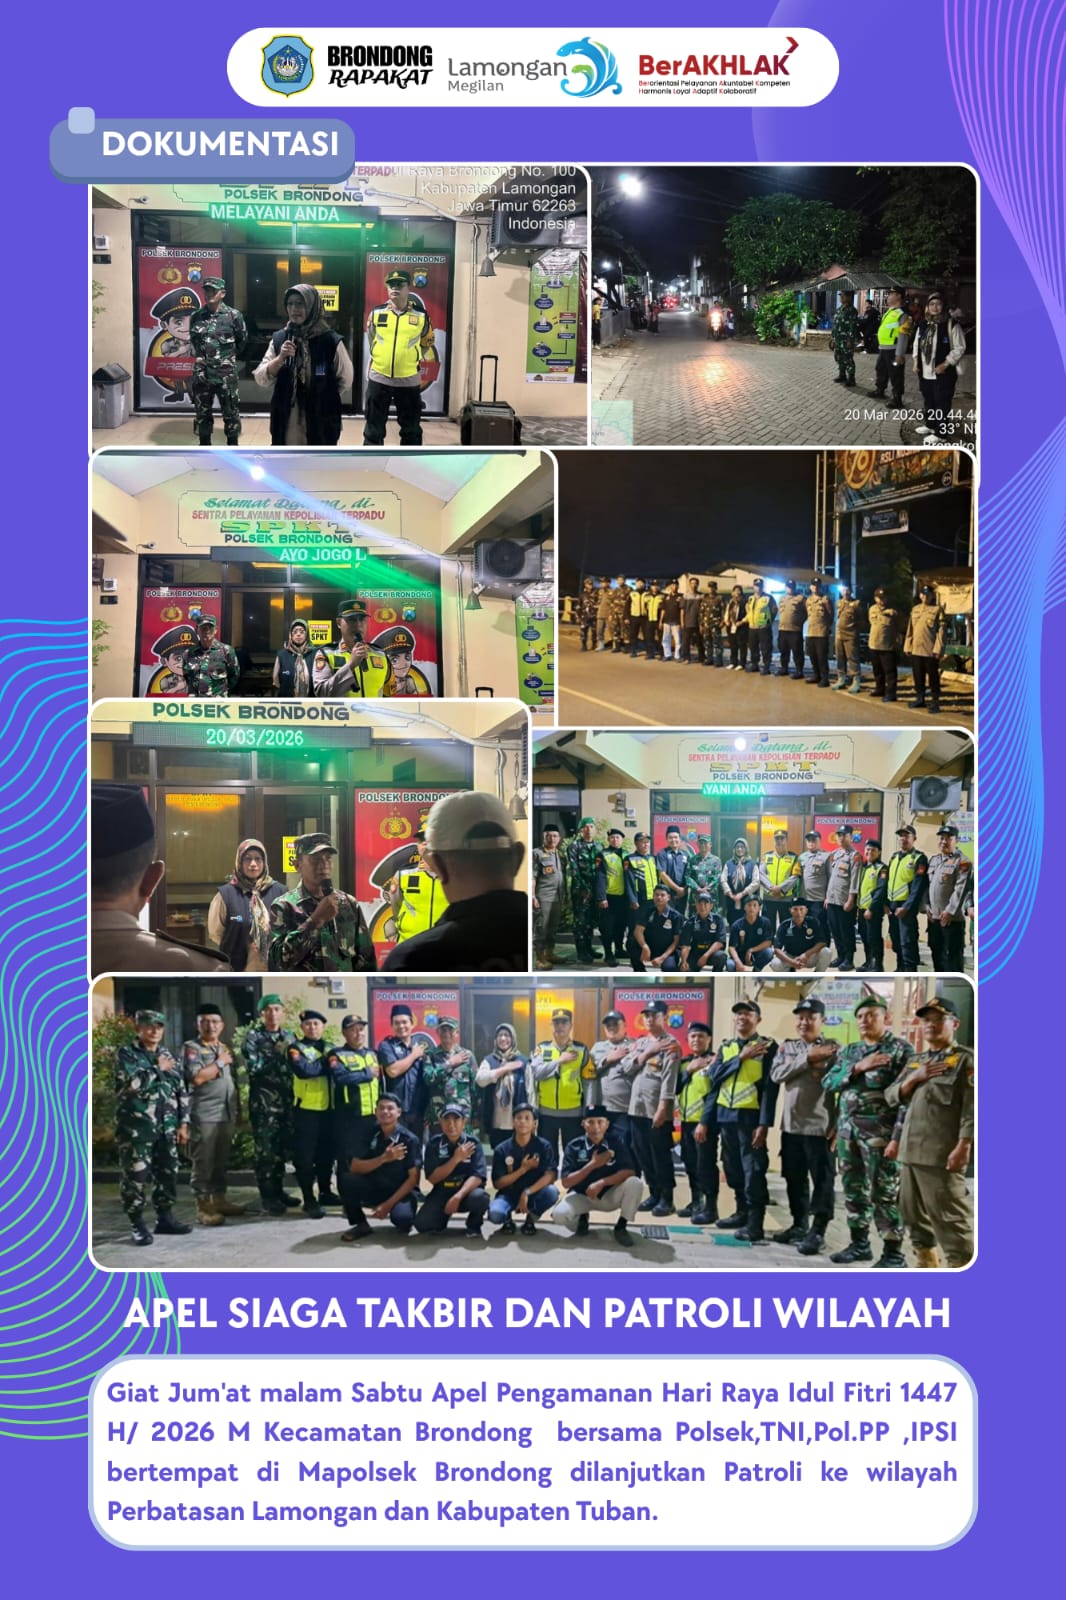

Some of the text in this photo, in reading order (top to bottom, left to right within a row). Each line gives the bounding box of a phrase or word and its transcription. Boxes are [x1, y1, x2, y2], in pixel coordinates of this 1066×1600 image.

[224, 189, 364, 202] POLSEK BRONDONG
[210, 204, 340, 221] MELAYANI ANDA
[175, 250, 219, 258] BRONDONG
[368, 254, 447, 263] POLSEK BRONDONG
[204, 497, 271, 509] Selamat
[192, 510, 227, 520] SENTRA
[230, 510, 281, 520] PELAYANAN
[224, 534, 353, 544] POLSEK BRONDONG
[280, 548, 308, 562] AYO
[311, 548, 352, 562] JOGO
[177, 590, 218, 598] BRONDONG
[359, 590, 432, 599] POLSEK BRONDONG
[311, 633, 328, 641] SPKT
[153, 702, 349, 720] POLSEK BRONDONG
[206, 728, 304, 746] 20/03/2026
[688, 753, 715, 762] SENTRA
[804, 752, 841, 761] TERPADU
[709, 761, 817, 773] SPKT
[713, 772, 814, 781] POLSEK BRONDONG
[733, 783, 766, 795] ANDA
[358, 792, 449, 803] POLSEK BRONDO
[618, 992, 705, 1000] POLSEK BRONDONG
